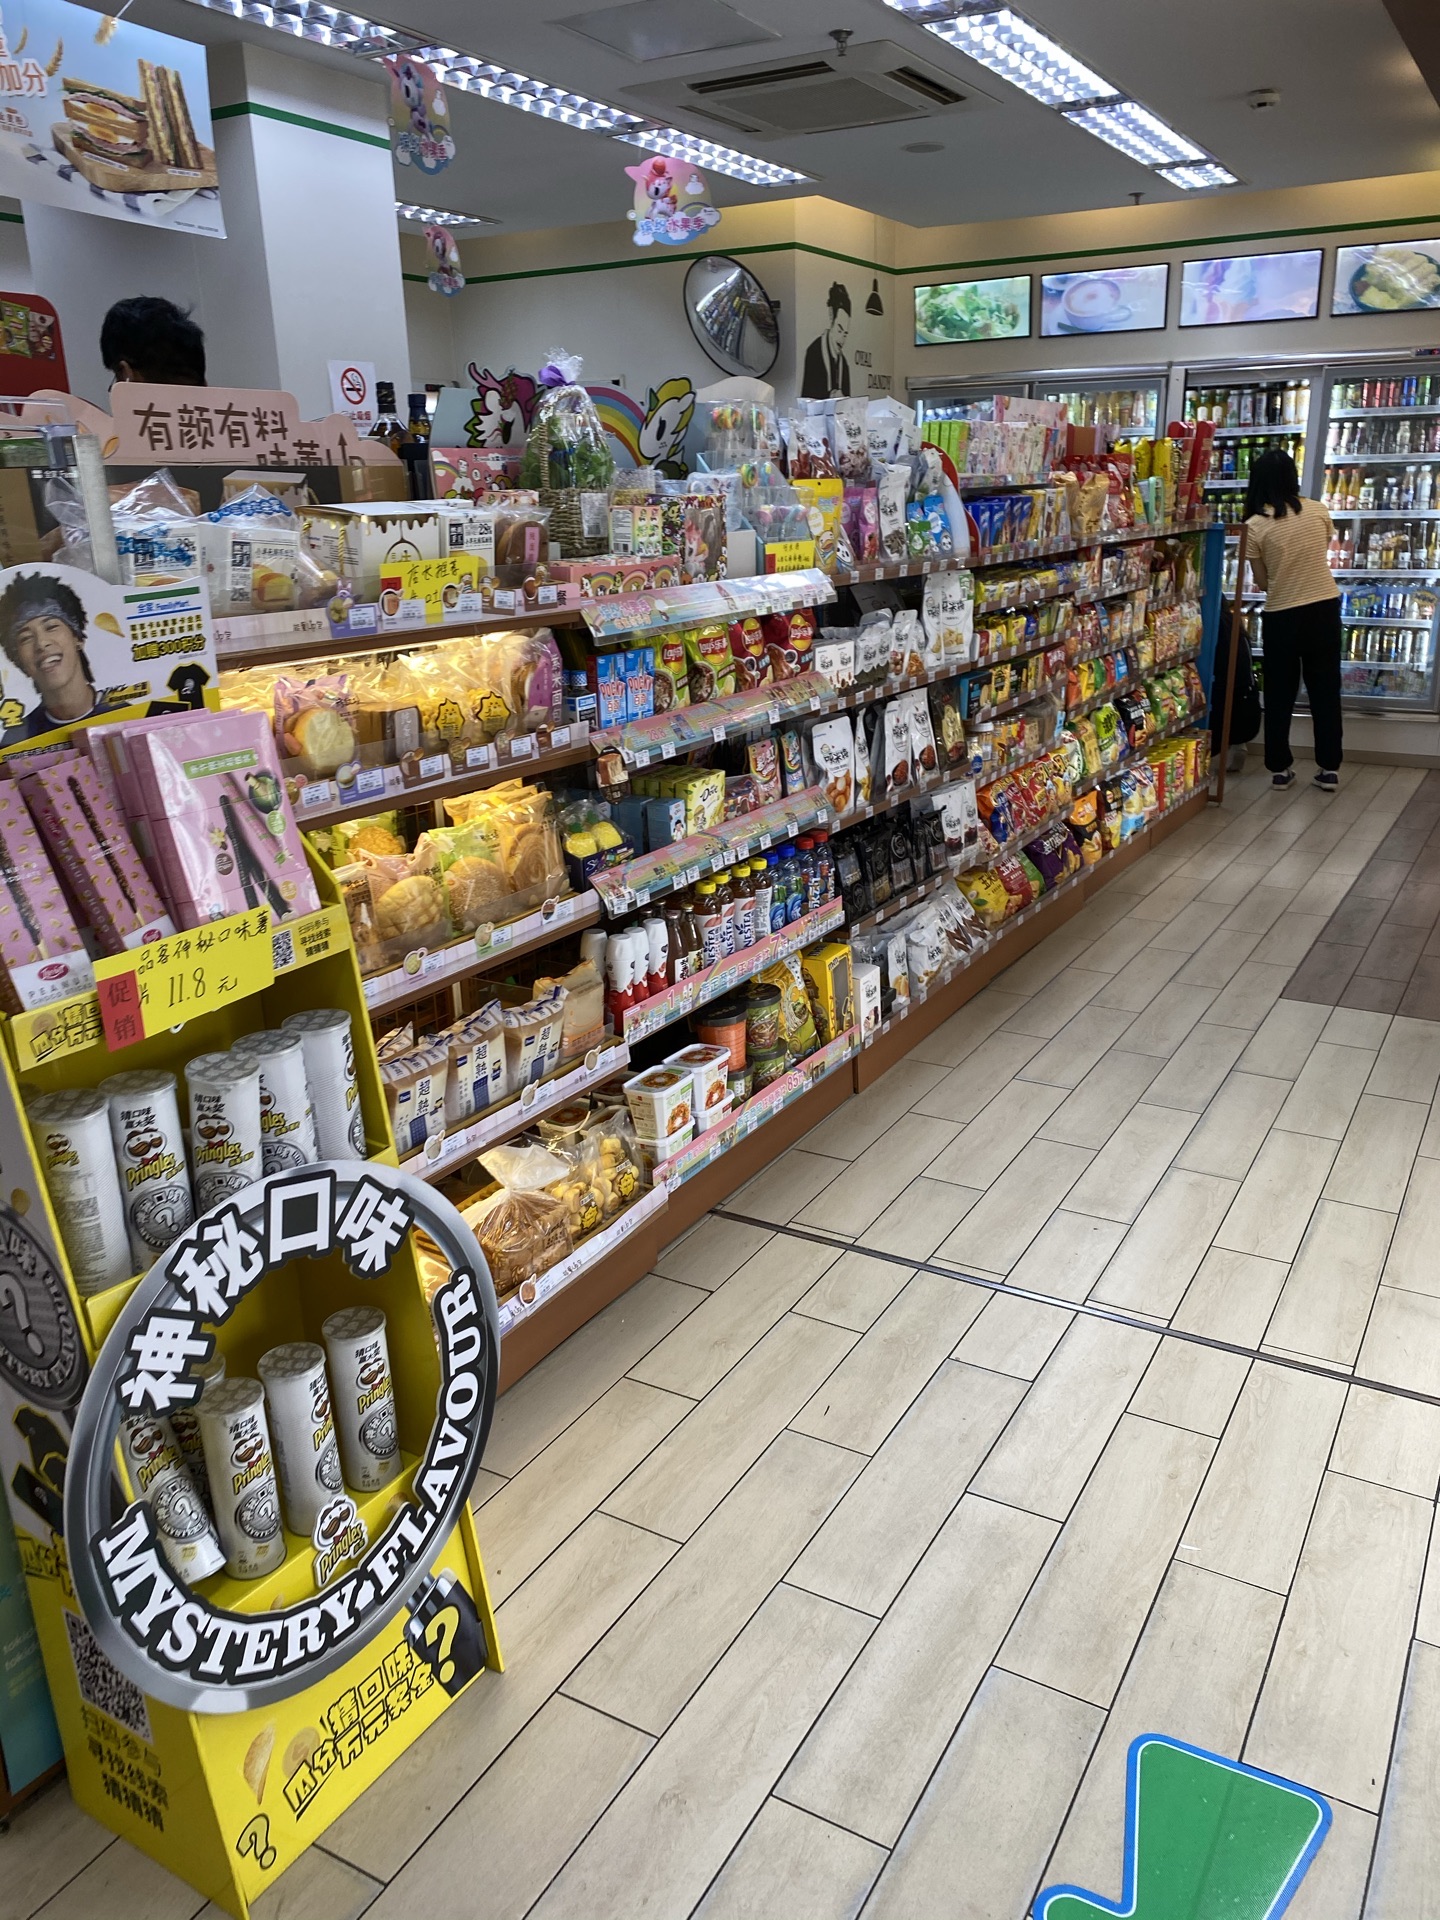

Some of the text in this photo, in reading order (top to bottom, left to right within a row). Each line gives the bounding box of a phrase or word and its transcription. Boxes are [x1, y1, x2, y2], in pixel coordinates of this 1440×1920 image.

[133, 402, 289, 451] 有颜有料
[138, 911, 269, 975] 品客神秘口味薯
[28, 974, 90, 999] PEANUT
[107, 979, 136, 1043] 促销
[168, 966, 206, 1008] 11.8
[217, 975, 238, 995] 元
[120, 1107, 152, 1121] 猜口味
[125, 1152, 175, 1191] Pringles
[195, 1141, 242, 1168] Pringles
[121, 1177, 404, 1411] 神秘口味
[100, 1272, 479, 1677] MYSTERY FLAVOUR
[320, 1522, 364, 1584] Pringles
[327, 1640, 415, 1737] 猜口味
[283, 1661, 435, 1814] 瓜分万元奖金
